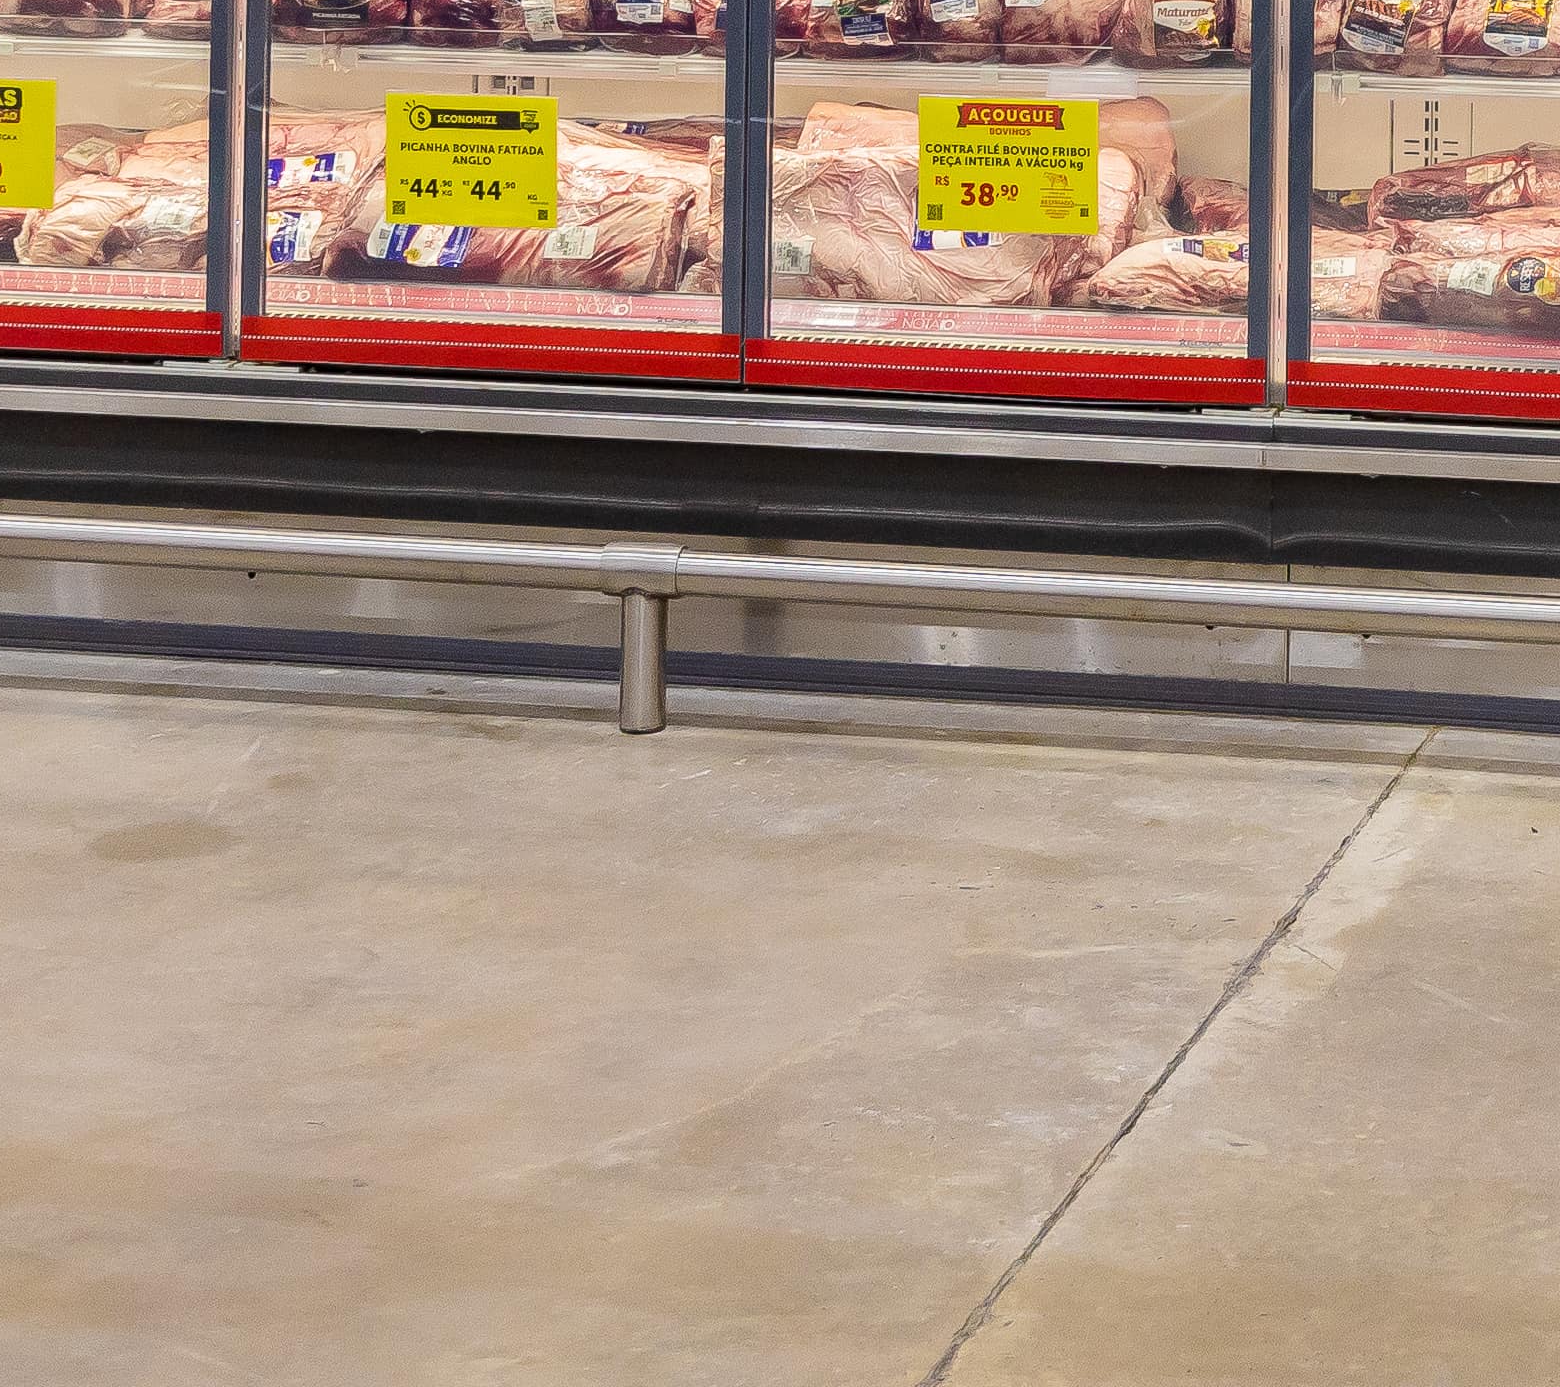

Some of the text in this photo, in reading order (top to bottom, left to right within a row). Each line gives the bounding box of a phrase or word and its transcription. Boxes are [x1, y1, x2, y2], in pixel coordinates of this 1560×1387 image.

[437, 114, 498, 125] ECONOMIZE
[968, 108, 1054, 125] AÇOUGUE
[990, 128, 1031, 136] BOVINOS
[400, 142, 544, 156] PICANHA BOVINA FATIADA
[925, 143, 1090, 157] CONTRA FILÉ BOVINO FRIBOI
[452, 156, 492, 165] ANGLO
[932, 156, 1083, 171] PEÇA INTEIRA A VÁCUO kg
[935, 176, 1019, 206] R$ 38,90
[903, 318, 956, 331] NOTA10
